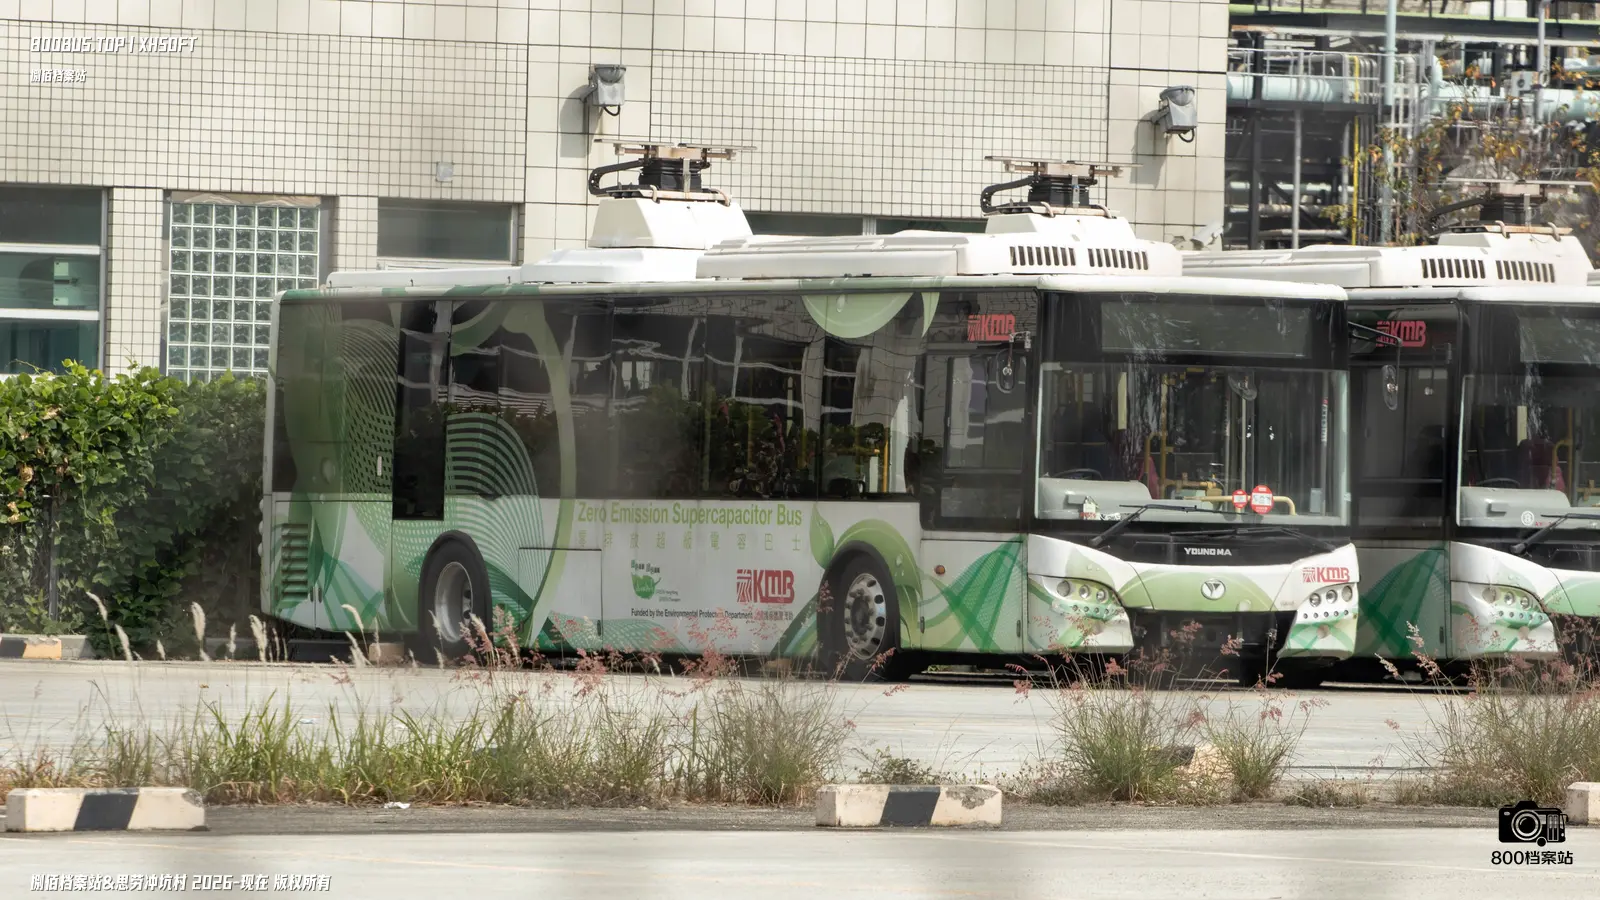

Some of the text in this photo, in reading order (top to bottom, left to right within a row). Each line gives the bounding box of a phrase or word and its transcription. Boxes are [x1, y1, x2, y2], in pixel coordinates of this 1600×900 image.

[577, 502, 802, 528] Zero Emission Supercapacitor Bus
[1316, 566, 1351, 583] KMB
[753, 569, 795, 604] KMB
[631, 608, 649, 617] Funded
[649, 609, 655, 619] by
[656, 609, 664, 618] the
[664, 609, 699, 618] Environmental
